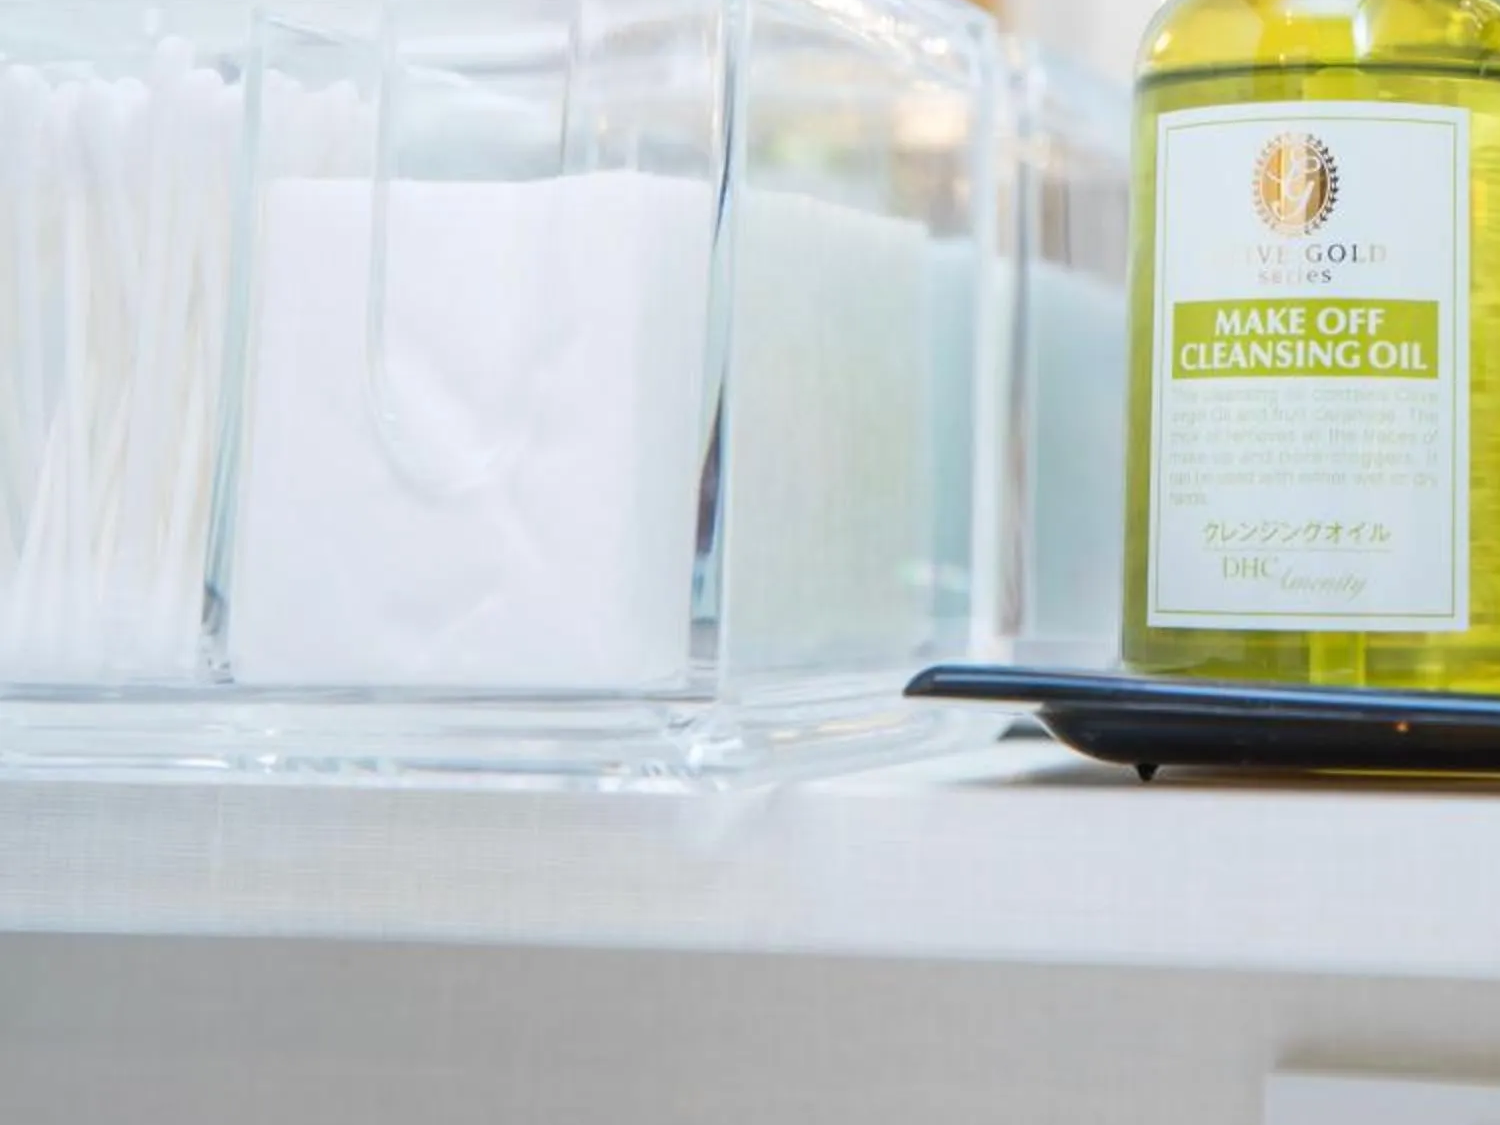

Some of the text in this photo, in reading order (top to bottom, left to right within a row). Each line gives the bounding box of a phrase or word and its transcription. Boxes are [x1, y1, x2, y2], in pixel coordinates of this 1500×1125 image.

[1304, 241, 1388, 264] GOLD
[1257, 267, 1332, 285] series
[1214, 306, 1387, 336] MAKE OFF
[1180, 339, 1428, 371] CLEANSING OIL
[1222, 555, 1278, 581] DHC
